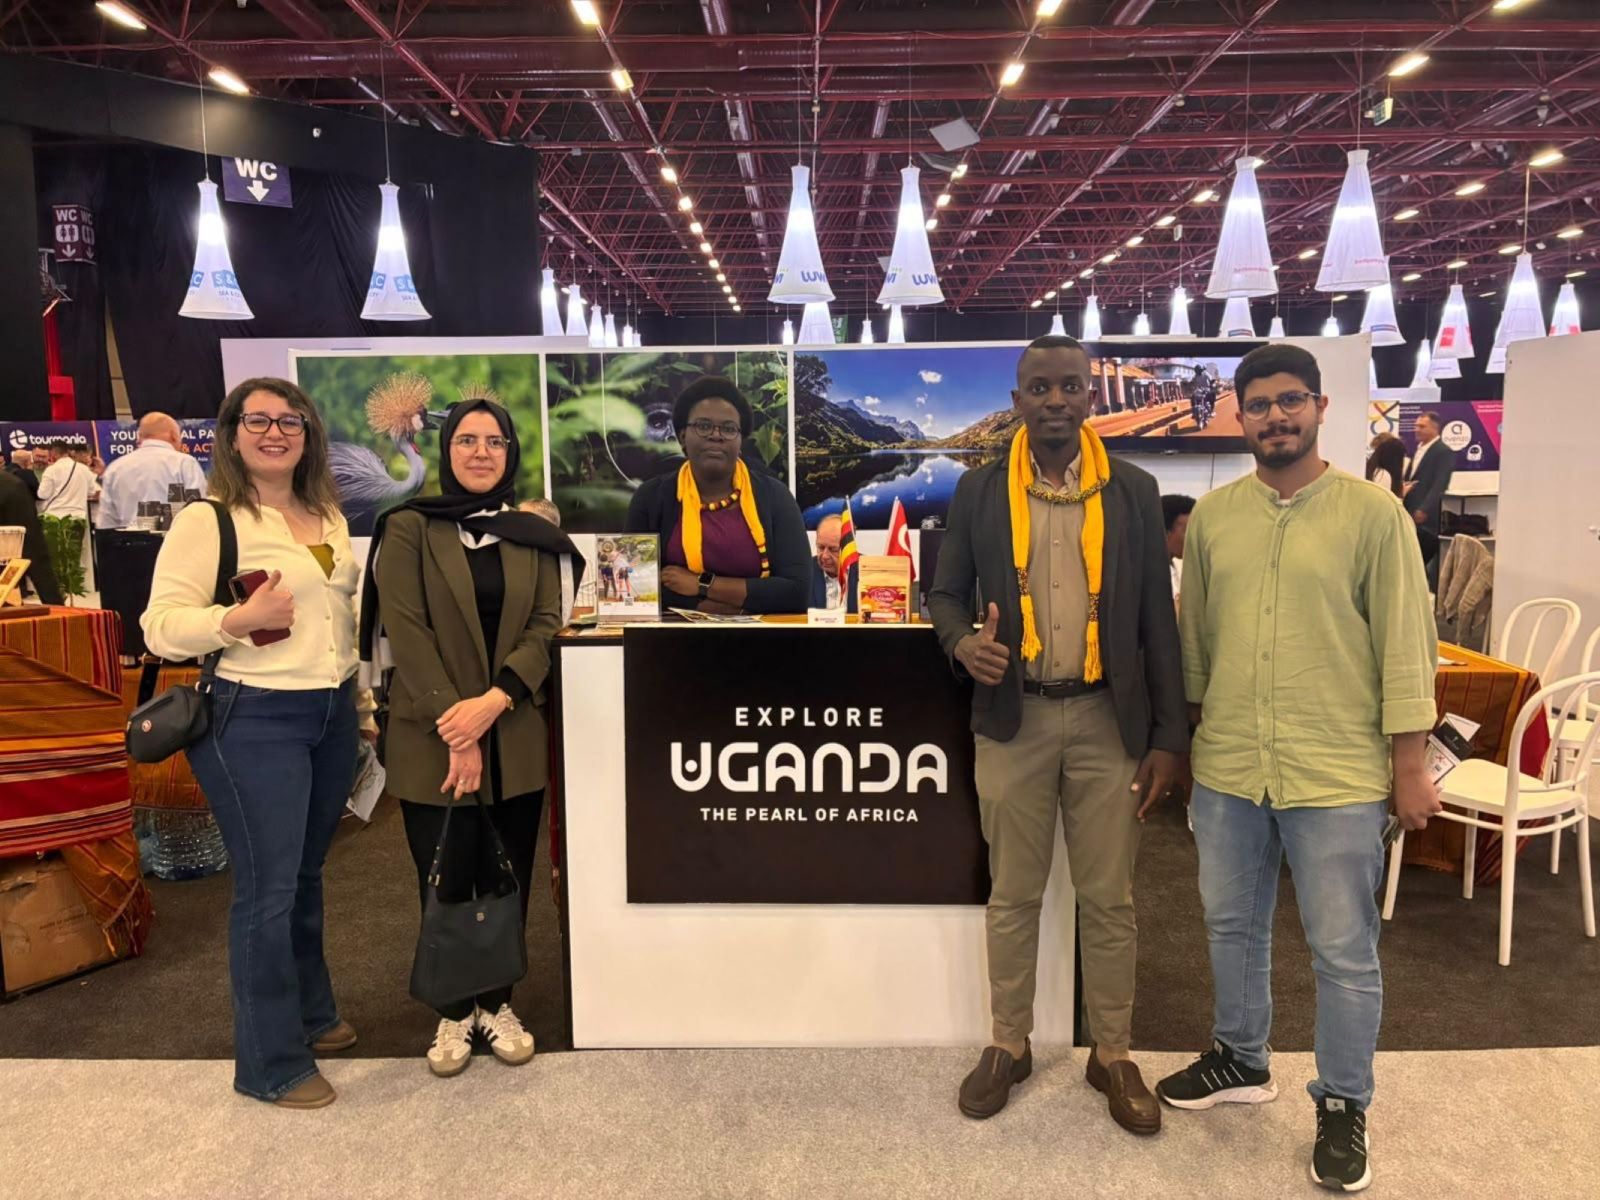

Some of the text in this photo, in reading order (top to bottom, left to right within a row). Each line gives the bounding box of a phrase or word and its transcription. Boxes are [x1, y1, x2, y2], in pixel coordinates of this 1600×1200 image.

[234, 157, 278, 181] WC
[56, 208, 78, 222] WC
[80, 209, 93, 225] WC
[29, 433, 87, 446] tourmania
[110, 430, 139, 441] YOU
[198, 429, 215, 439] PA
[110, 444, 134, 455] FOR
[193, 443, 214, 453] ACT
[735, 707, 883, 727] EXPLORE
[670, 741, 948, 794] UGANDA
[700, 807, 919, 822] THE PEARL OF AFRICA
